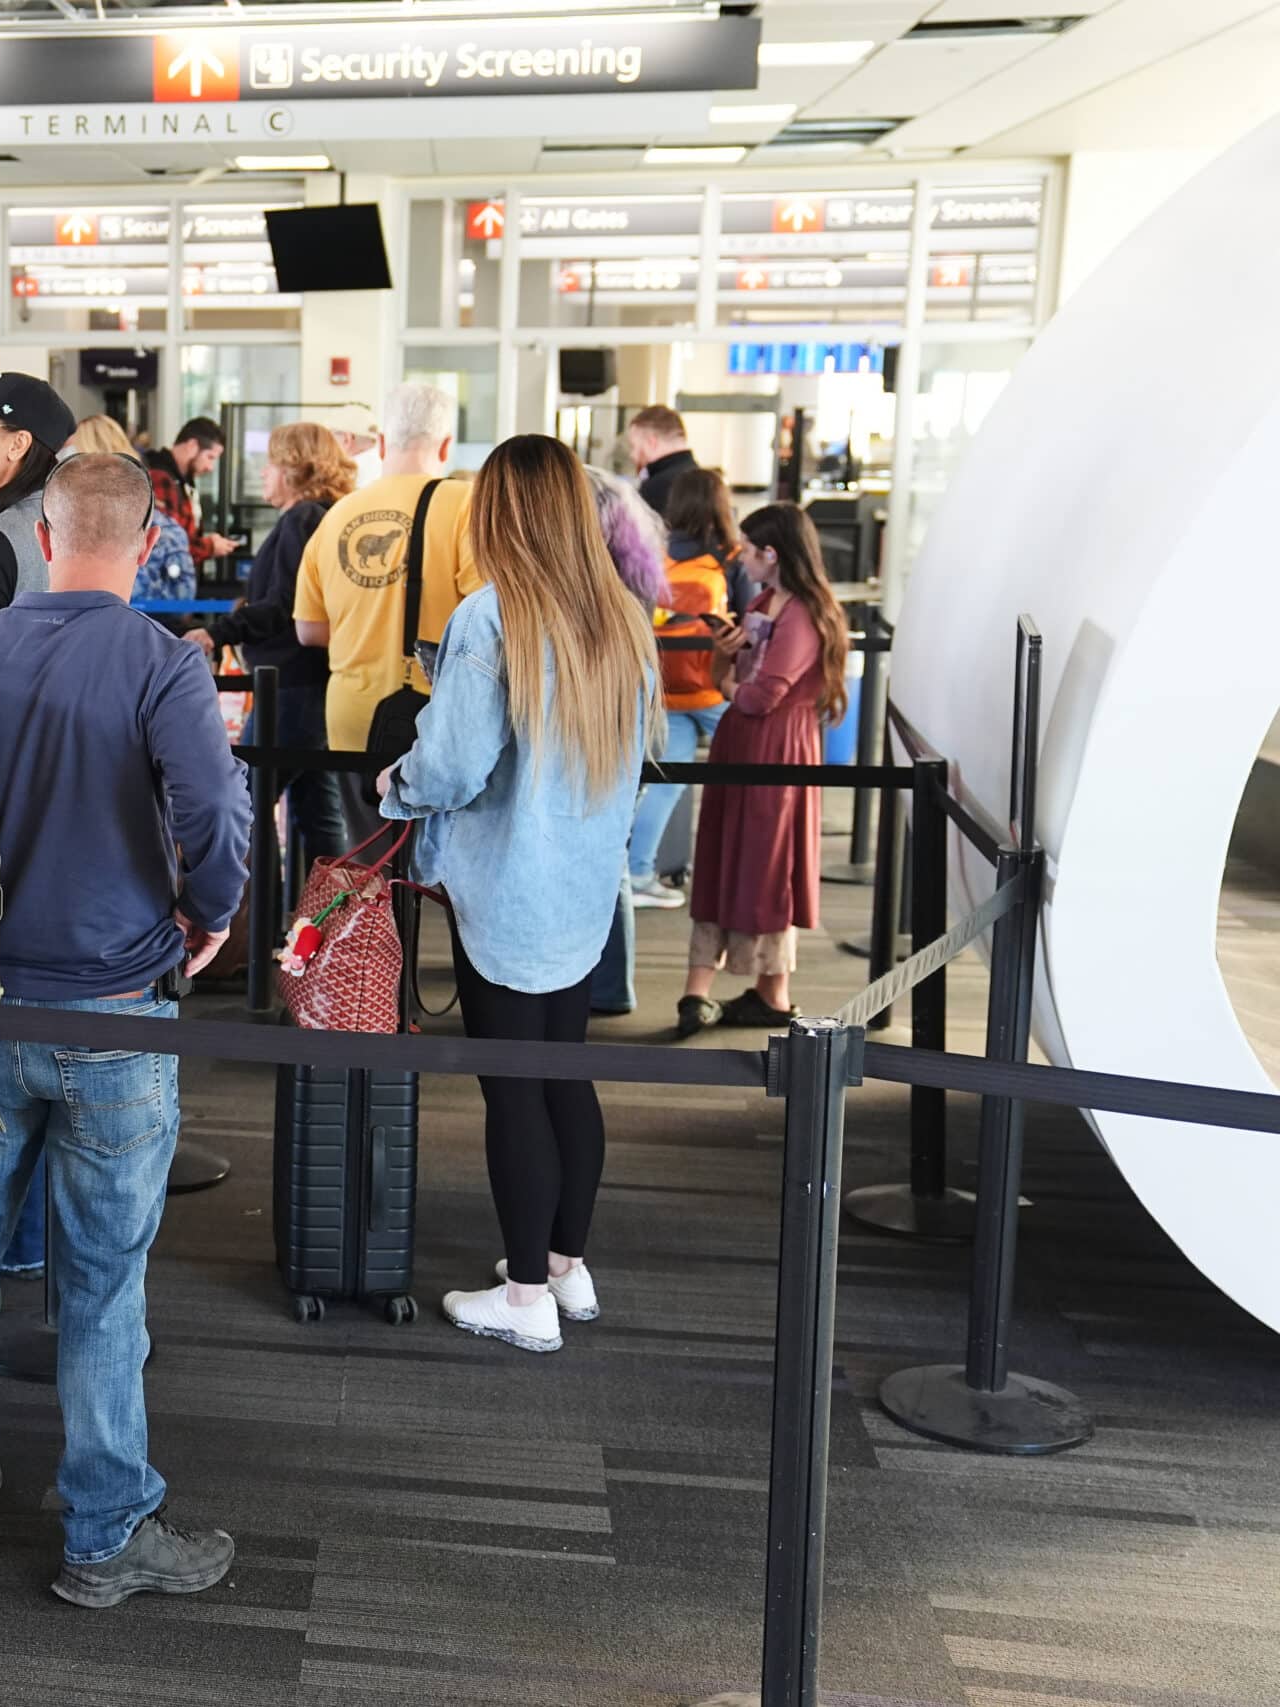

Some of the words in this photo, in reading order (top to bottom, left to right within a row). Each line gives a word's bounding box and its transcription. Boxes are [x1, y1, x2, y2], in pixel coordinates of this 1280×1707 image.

[301, 43, 446, 87] Security
[456, 38, 642, 84] Screening
[19, 110, 238, 137] TERMINAL
[268, 111, 286, 133] C
[542, 208, 570, 230] All
[571, 208, 629, 230] Gates
[853, 199, 939, 226] Secury
[123, 216, 194, 240] Secury
[195, 215, 267, 237] Screenin
[340, 518, 361, 540] SAN
[363, 511, 397, 521] DIEGO
